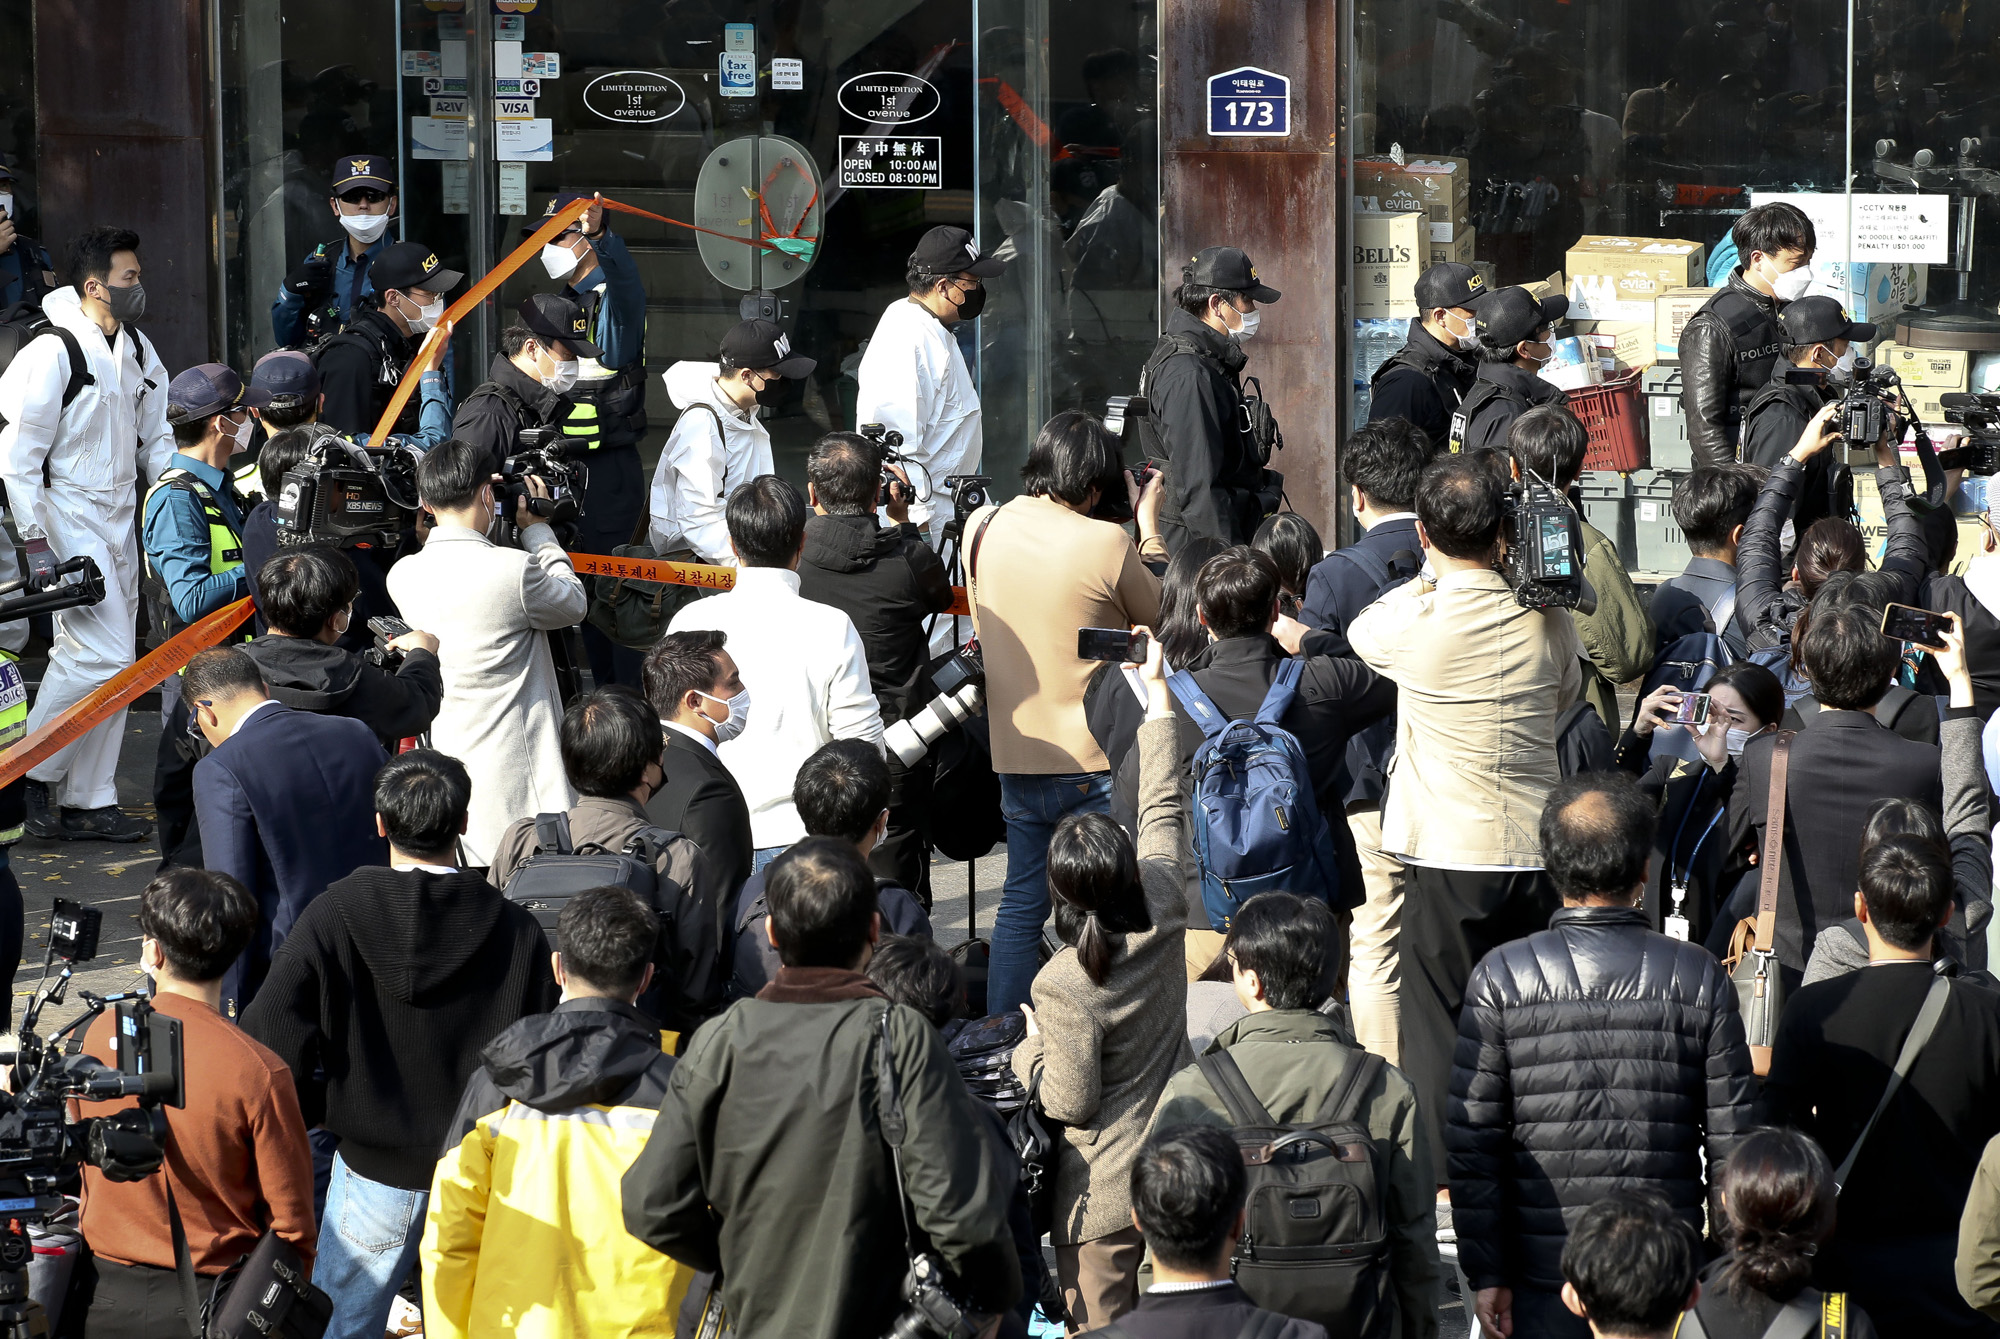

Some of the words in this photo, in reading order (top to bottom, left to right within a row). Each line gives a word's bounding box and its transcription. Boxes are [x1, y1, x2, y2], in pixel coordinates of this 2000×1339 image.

[727, 60, 747, 70] tax
[727, 70, 751, 80] free
[524, 83, 538, 92] UC
[1232, 79, 1265, 88] 이태원로
[856, 85, 889, 93] LIMITED
[627, 94, 642, 105] 1st
[881, 95, 896, 106] 1st
[502, 103, 529, 113] VISA
[614, 109, 656, 117] avenue
[868, 110, 910, 118] avenue
[1225, 101, 1274, 127] 173
[857, 141, 925, 156] 年中無休
[844, 159, 872, 170] OPEN
[889, 160, 920, 170] 10:00
[922, 160, 937, 170] AM
[844, 172, 885, 183] CLOSED
[889, 173, 920, 183] 08:00
[922, 173, 937, 183] PM
[1385, 198, 1421, 209] evian
[1858, 242, 1889, 250] PENALTY
[1620, 278, 1656, 289] evian
[1740, 342, 1779, 361] POLICE
[346, 492, 360, 500] HD
[346, 502, 361, 510] KBS
[361, 502, 383, 511] NEWS
[585, 560, 657, 581] 경찰통제선
[674, 570, 734, 590] 경찰서장
